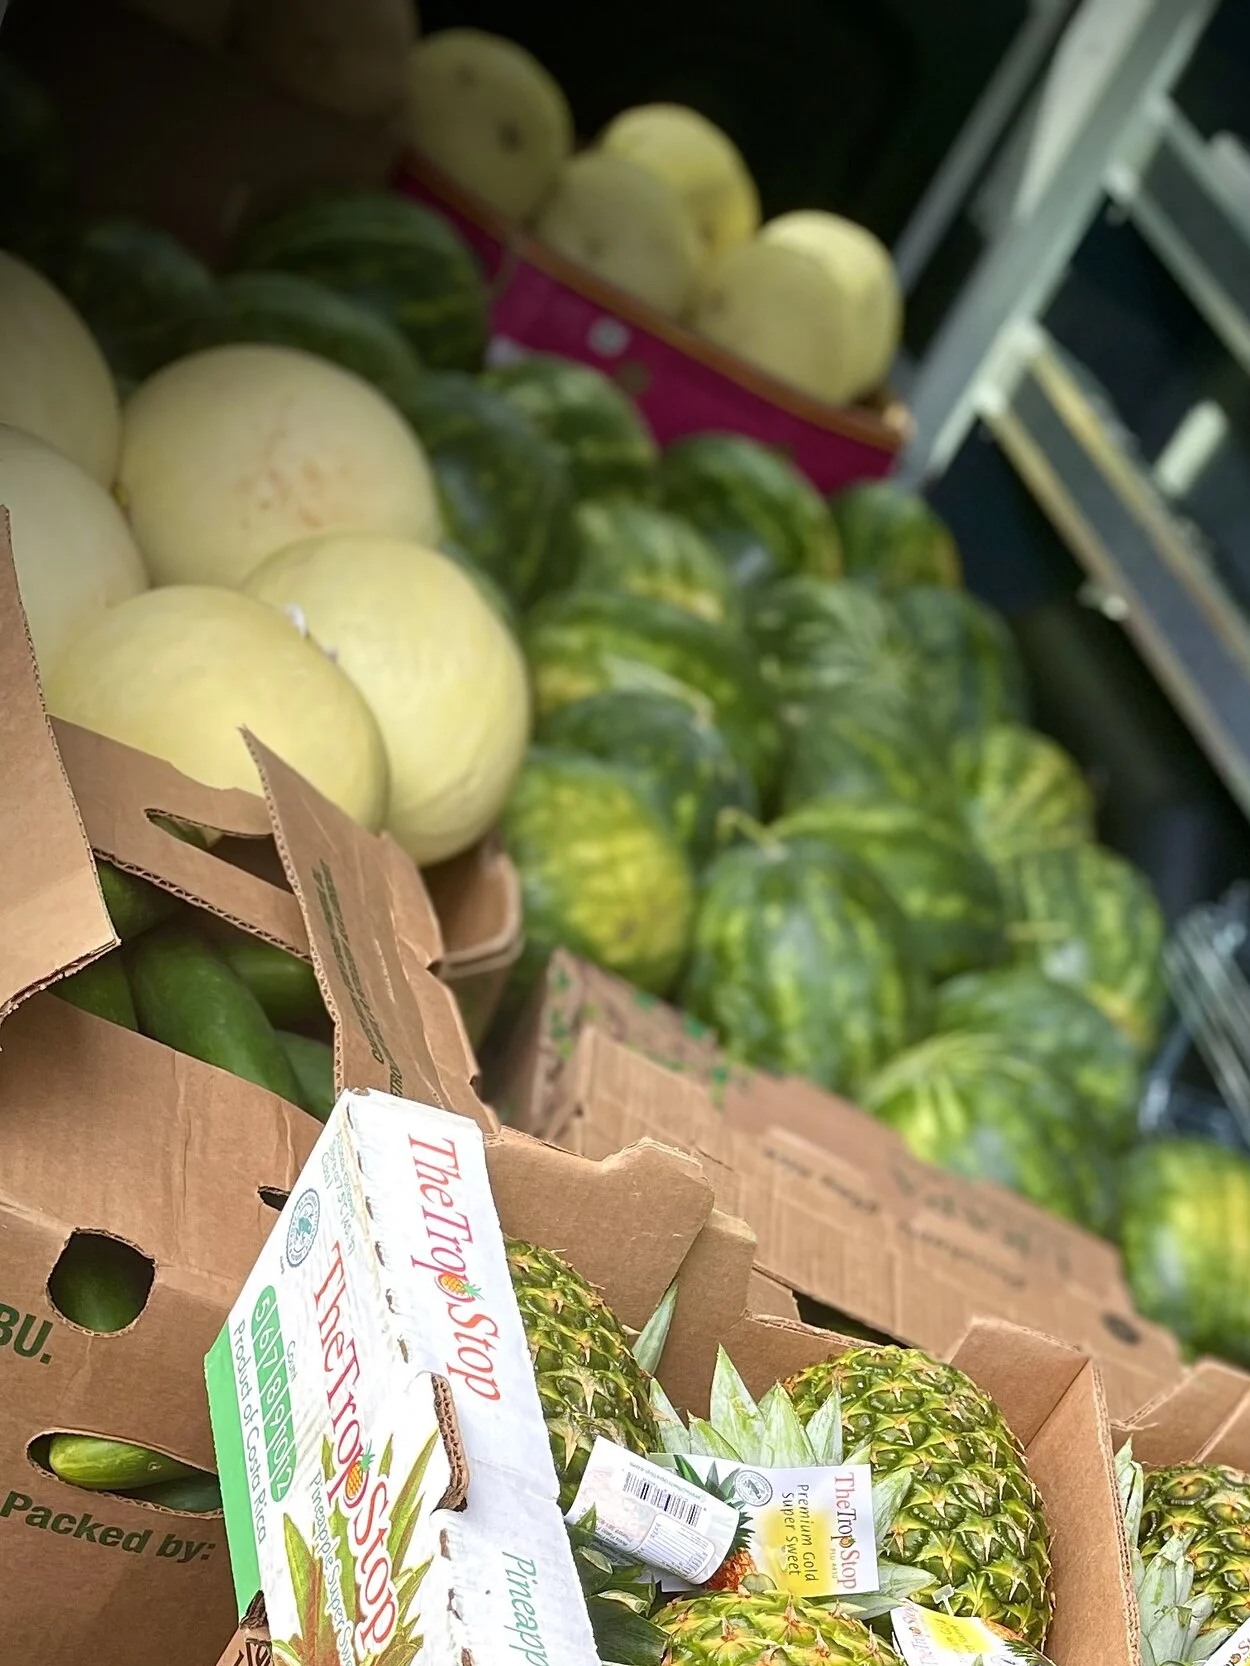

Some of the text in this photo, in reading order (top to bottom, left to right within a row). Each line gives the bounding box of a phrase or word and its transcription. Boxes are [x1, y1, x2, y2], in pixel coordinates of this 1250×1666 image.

[233, 1319, 267, 1545] Product of Costa Rica
[1, 1490, 216, 1564] Packed by:
[309, 1469, 334, 1566] Pineapple
[325, 1565, 346, 1629] Super
[780, 1492, 801, 1576] Super Sweet
[796, 1484, 816, 1582] Premium Gold
